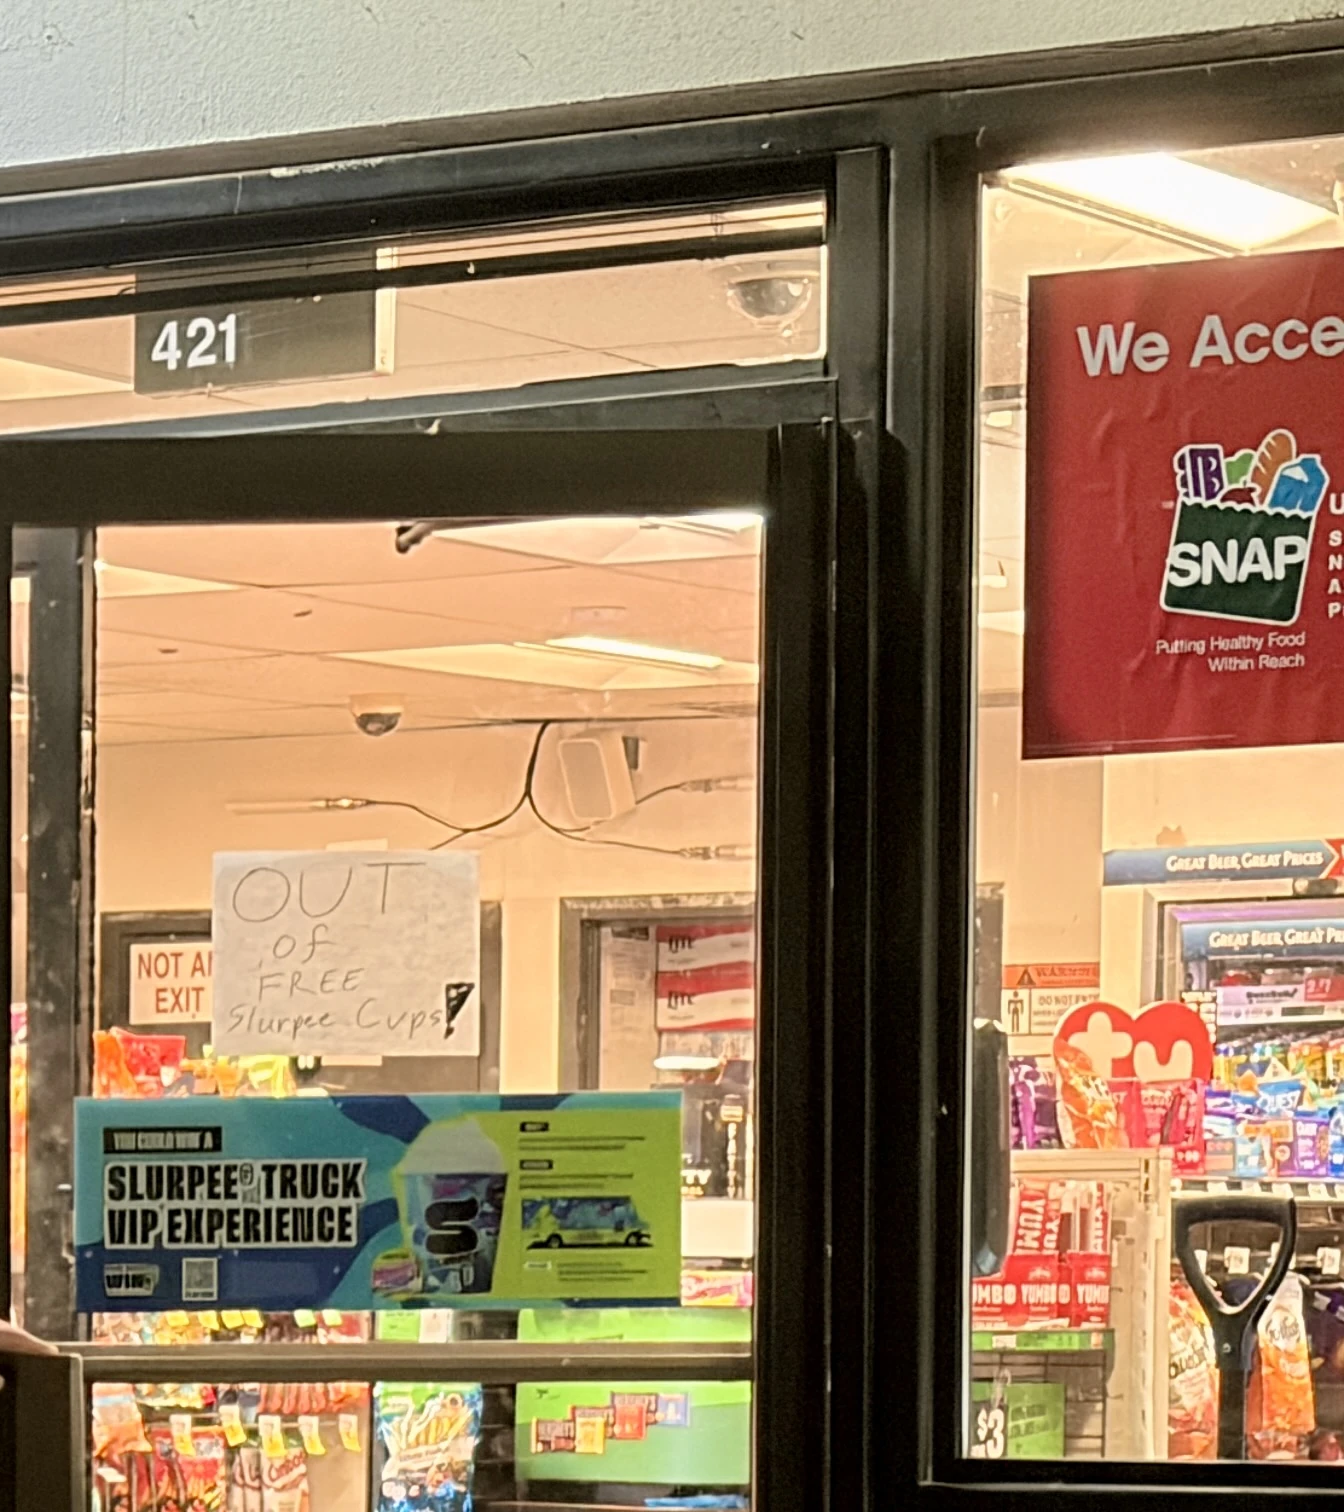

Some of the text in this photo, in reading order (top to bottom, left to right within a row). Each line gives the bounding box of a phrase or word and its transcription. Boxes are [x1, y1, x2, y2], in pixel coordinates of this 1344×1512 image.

[151, 313, 236, 370] 421
[1076, 321, 1170, 377] We
[1167, 536, 1308, 587] SNAP
[1156, 631, 1305, 656] Putting Healthy Food
[1208, 652, 1305, 672] Within Reach
[232, 862, 427, 923] OUT
[138, 951, 183, 979] NOT
[155, 987, 205, 1015] EXIT
[259, 968, 365, 1001] FREE
[228, 1008, 334, 1040] Slurpee
[261, 1163, 363, 1199] TRUCK
[108, 1206, 353, 1245] VIP EXPERIENCE
